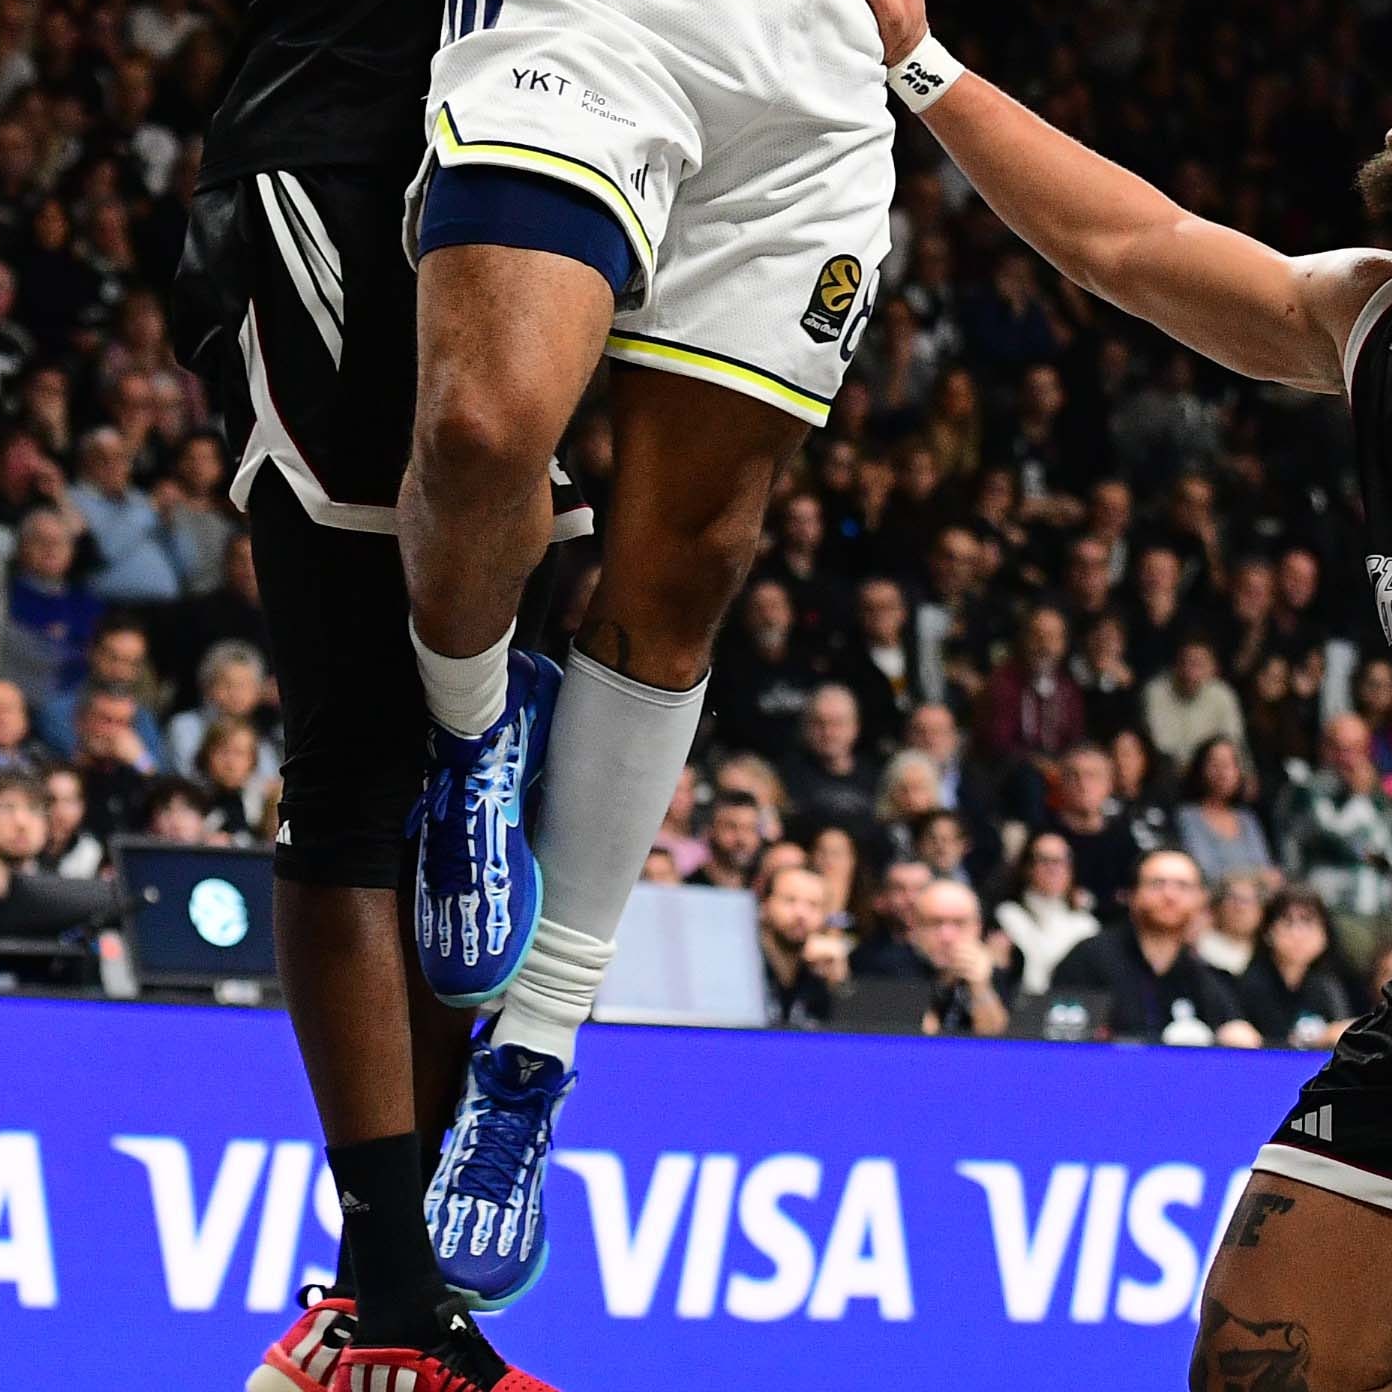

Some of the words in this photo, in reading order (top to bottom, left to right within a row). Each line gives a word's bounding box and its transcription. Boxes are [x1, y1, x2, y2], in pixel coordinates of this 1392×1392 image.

[512, 67, 572, 96] YKT
[583, 89, 606, 106] Filo
[551, 1149, 916, 1323] VISA
